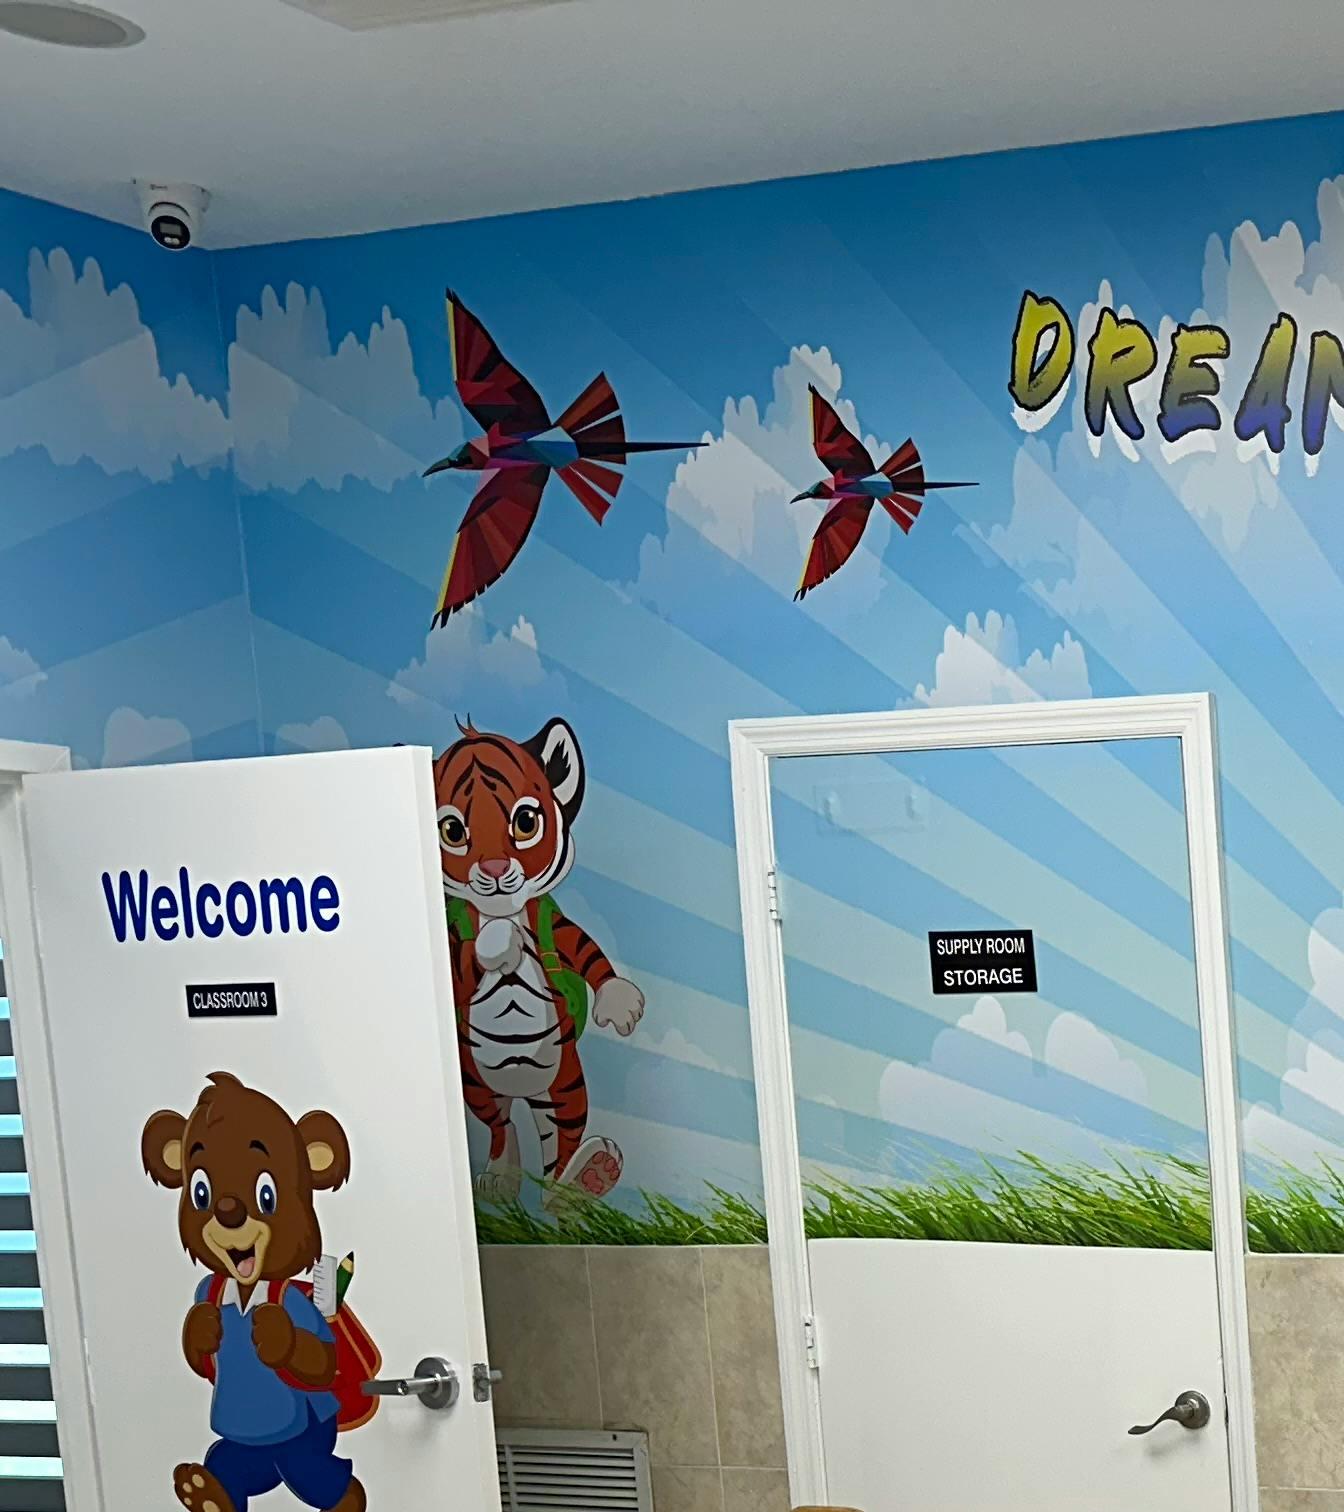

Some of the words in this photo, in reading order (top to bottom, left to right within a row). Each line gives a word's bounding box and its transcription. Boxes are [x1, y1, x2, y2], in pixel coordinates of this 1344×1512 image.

[101, 866, 340, 943] Welcome
[936, 938, 983, 955] SUPPLY
[986, 937, 1025, 954] ROOM
[943, 968, 1024, 986] STORAGE
[193, 991, 259, 1009] CLASSROOM
[260, 991, 268, 1008] 3
